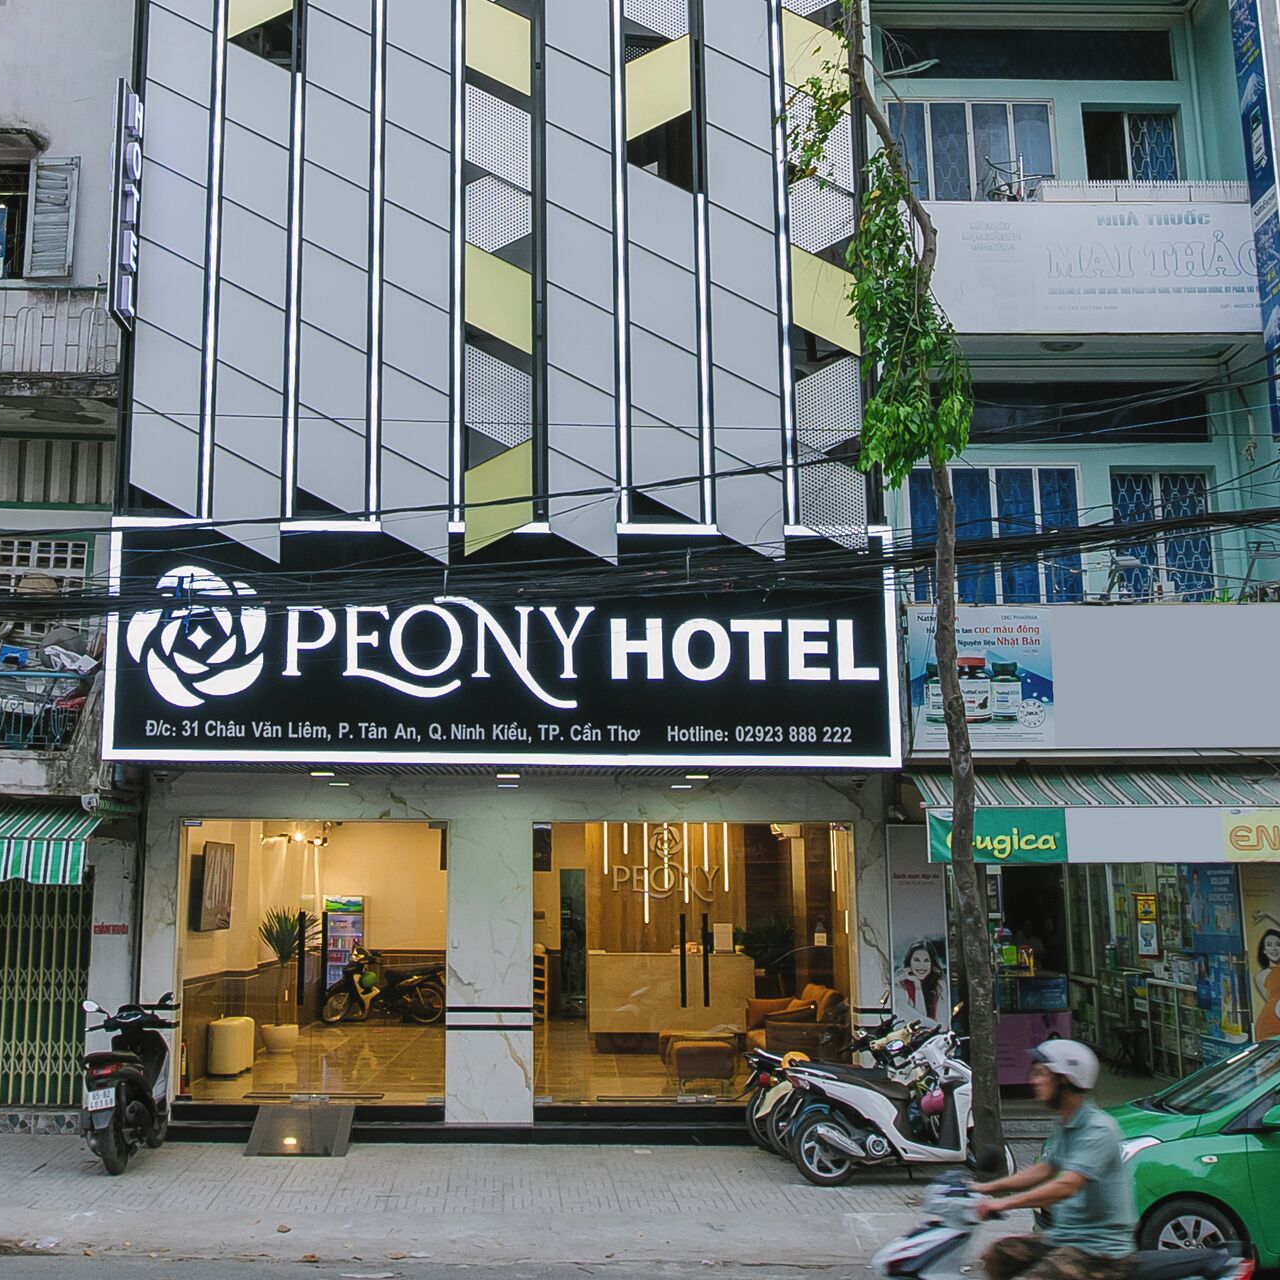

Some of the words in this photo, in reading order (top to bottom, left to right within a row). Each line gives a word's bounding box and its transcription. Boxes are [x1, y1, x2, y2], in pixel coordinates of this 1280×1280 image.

[119, 92, 144, 318] HOTEL
[1097, 208, 1140, 227] NHÀ
[1147, 207, 1212, 226] THUỐC
[1047, 240, 1136, 279] MAI
[974, 625, 991, 637] cục
[993, 624, 1014, 634] máu
[1016, 624, 1040, 637] đông
[983, 639, 996, 647] liệu
[996, 636, 1020, 648] Nhật
[1021, 636, 1041, 646] Bản
[282, 596, 595, 708] PEONY
[610, 618, 880, 682] HOTEL
[145, 720, 177, 738] Đ/c:
[182, 720, 199, 738] 31
[204, 720, 246, 739] Châu
[252, 721, 282, 739] Văn
[288, 721, 331, 741] Liêm,
[338, 722, 354, 739] P.
[358, 722, 388, 740] Tân
[394, 723, 421, 742] An,
[428, 723, 447, 742] Q.
[451, 723, 486, 740] Ninh
[491, 722, 532, 743] Kiều,
[538, 724, 564, 741] TP.
[570, 721, 602, 741] Cần
[606, 725, 641, 742] Thơ
[667, 725, 729, 742] Hotline:
[735, 726, 783, 742] 02923
[788, 726, 817, 743] 888
[822, 726, 852, 743] 222
[611, 861, 720, 902] PEONY
